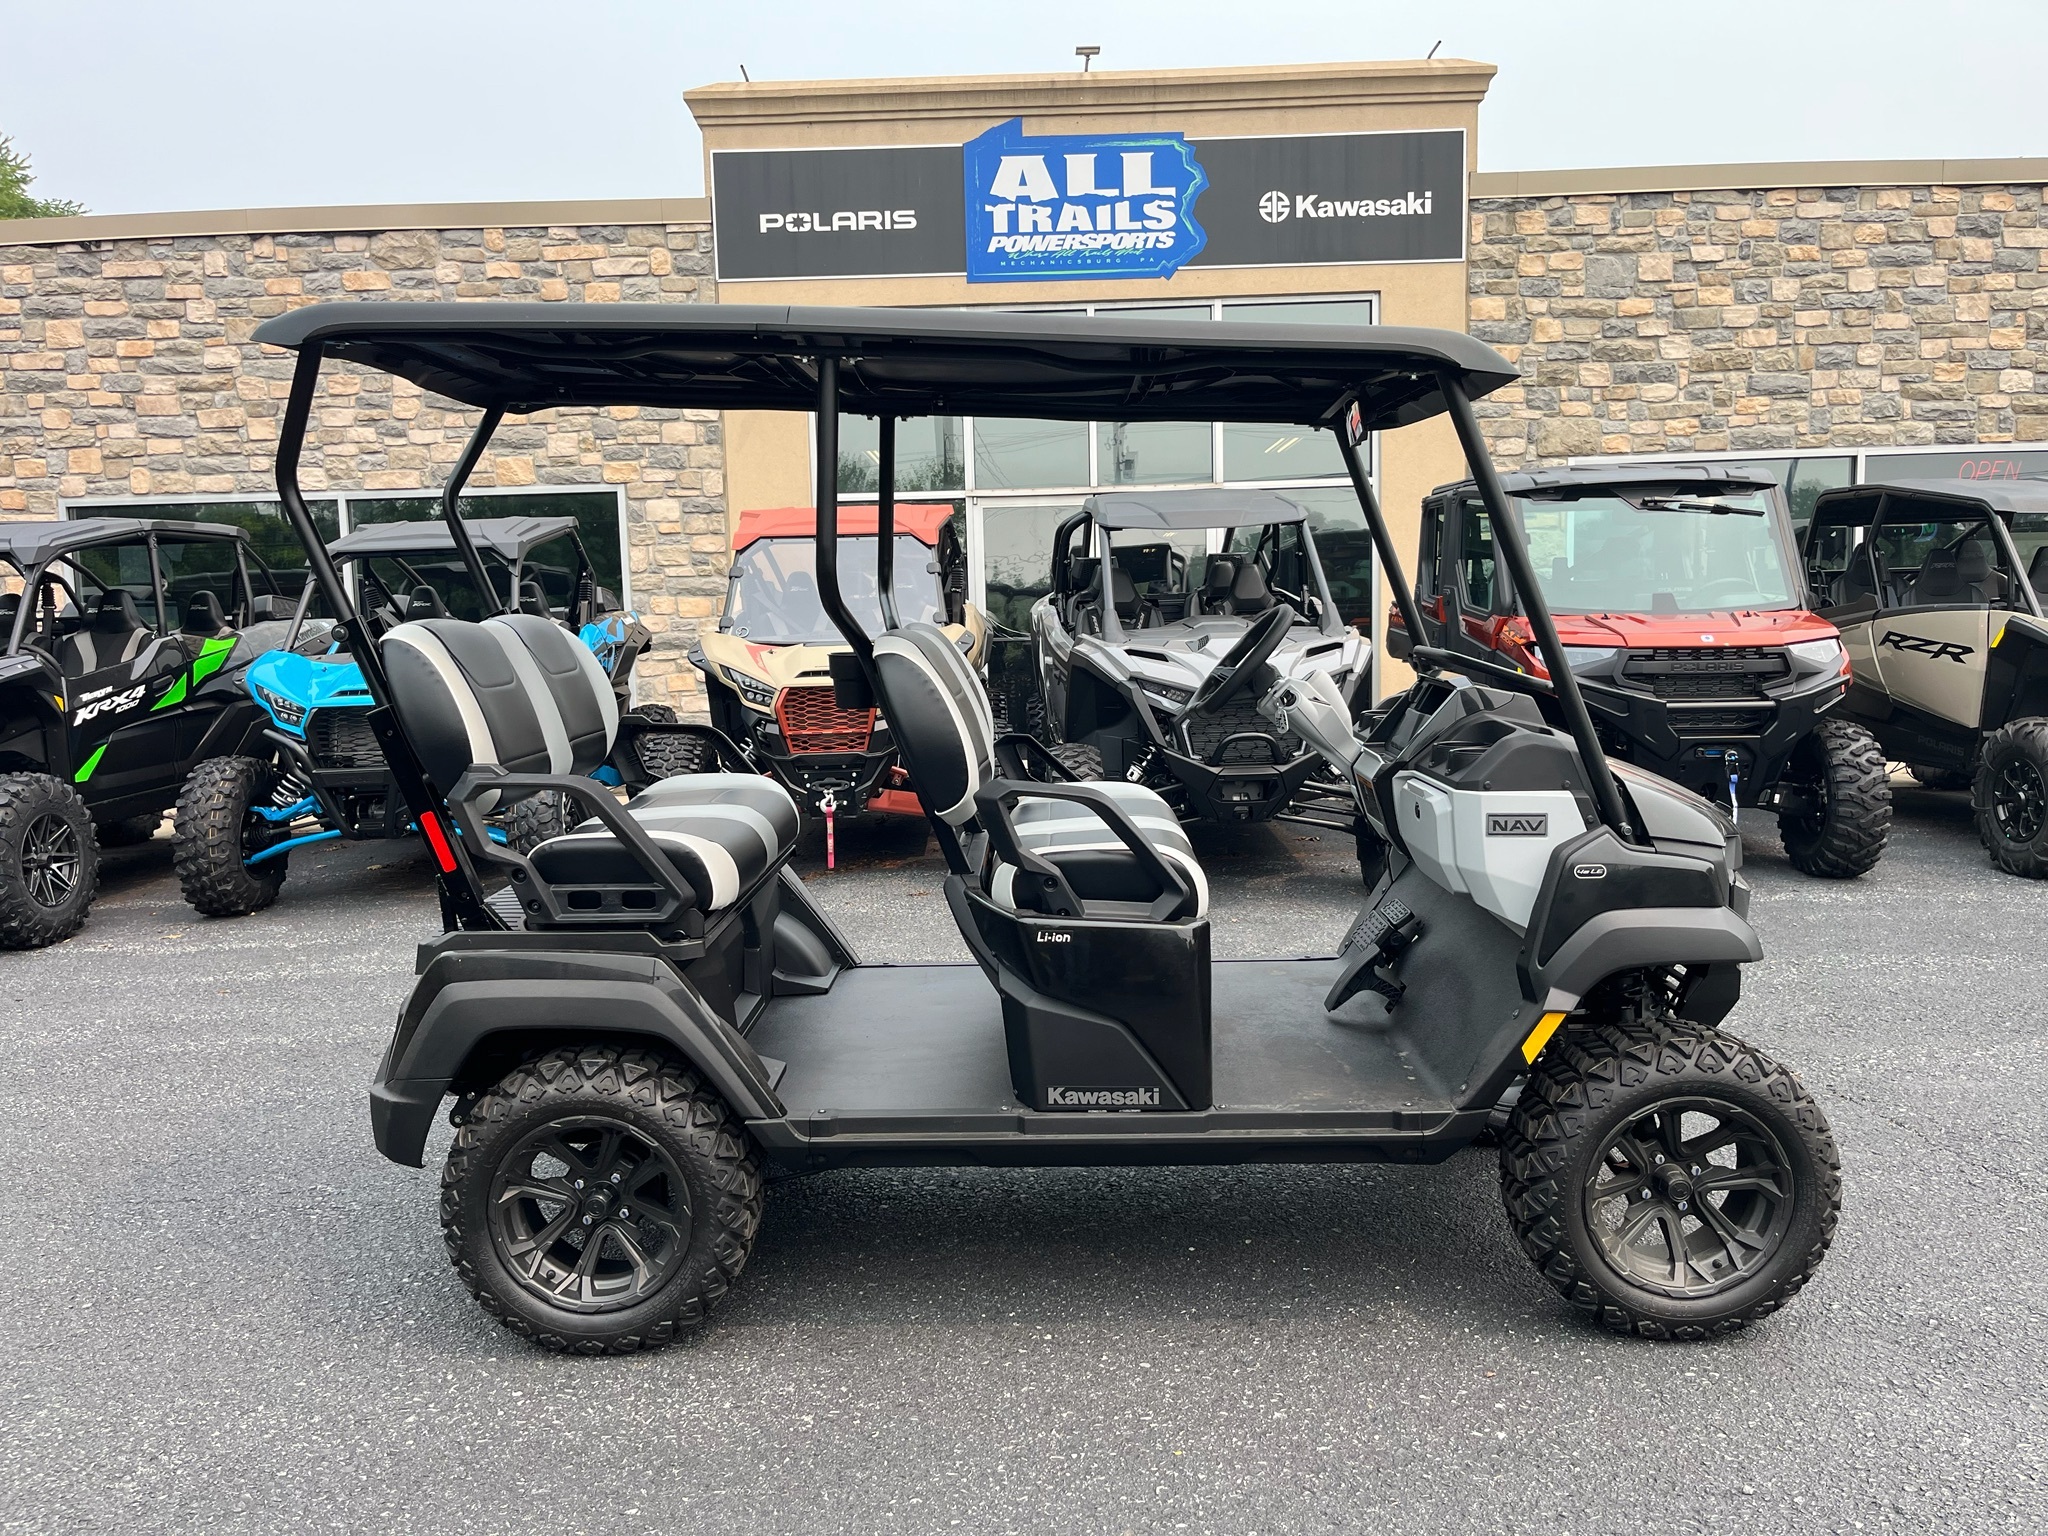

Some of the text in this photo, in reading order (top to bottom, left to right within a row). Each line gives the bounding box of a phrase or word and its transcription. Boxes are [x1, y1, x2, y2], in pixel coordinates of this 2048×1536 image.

[989, 152, 1176, 203] ALL
[1295, 191, 1432, 219] Kawasaki
[759, 210, 918, 233] POLARIS
[985, 200, 1177, 233] TRAILS
[987, 231, 1176, 253] POWERSPORTS
[1878, 630, 1976, 665] RZR
[1671, 661, 1745, 673] POLARIS
[115, 699, 140, 714] 1000
[1918, 735, 1965, 756] POLARIS
[1492, 819, 1544, 832] NAV
[1037, 931, 1071, 943] Li-ion
[1047, 1087, 1160, 1106] Kawasaki
